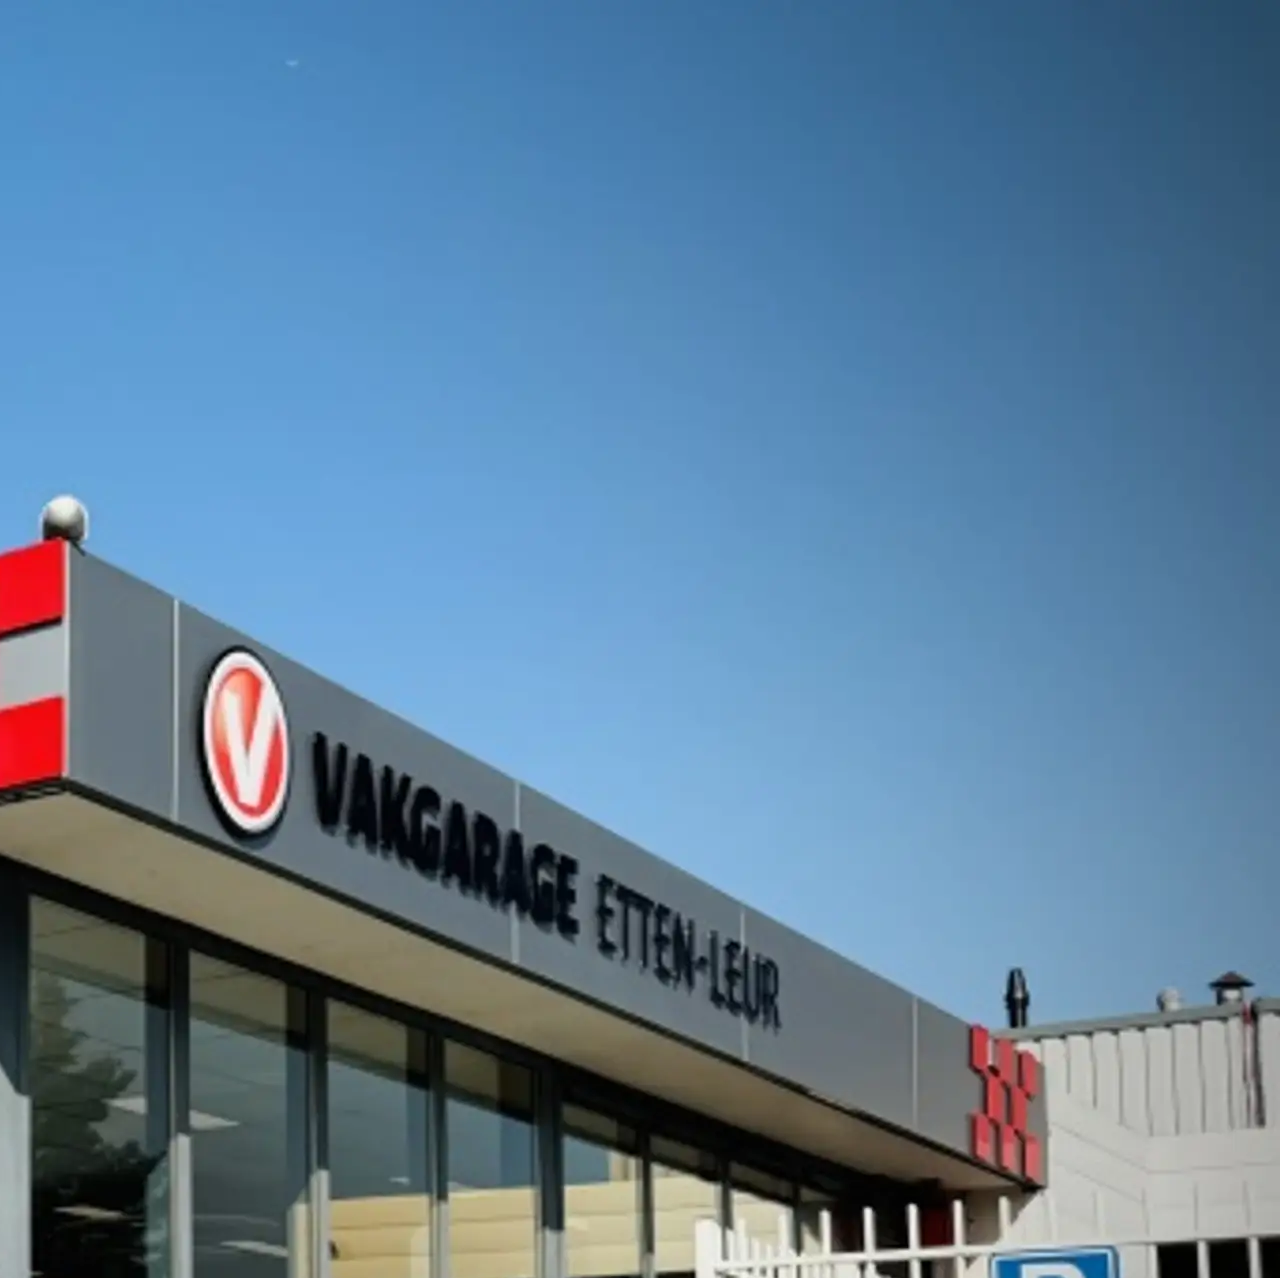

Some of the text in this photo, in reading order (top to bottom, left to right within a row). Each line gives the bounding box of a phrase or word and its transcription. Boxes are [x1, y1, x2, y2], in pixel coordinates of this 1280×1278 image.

[218, 670, 284, 809] V
[311, 731, 782, 1036] VAKGARAGE ETTEN-LEUR
